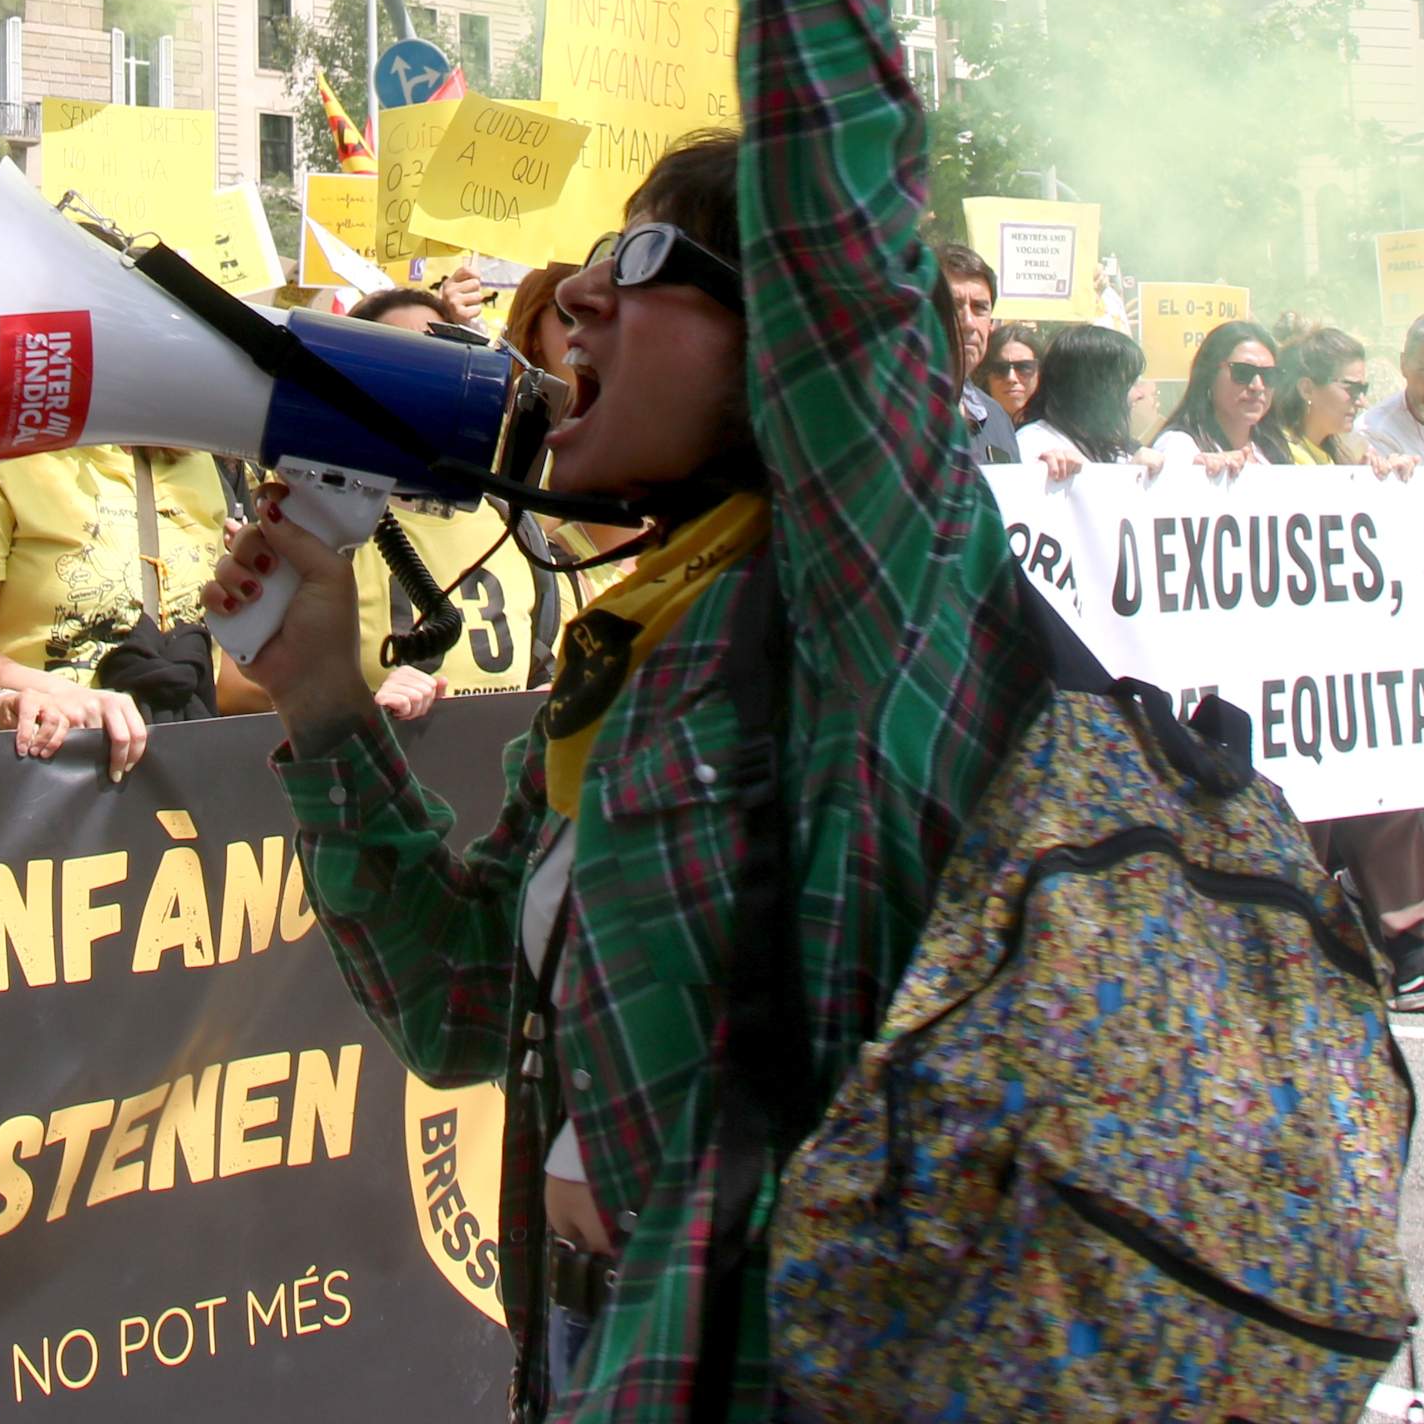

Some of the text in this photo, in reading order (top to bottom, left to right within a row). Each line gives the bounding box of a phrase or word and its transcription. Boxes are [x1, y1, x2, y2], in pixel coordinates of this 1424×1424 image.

[567, 44, 727, 116] VACANCES DE
[140, 115, 203, 146] DRETS
[474, 108, 550, 148] CUIDEU
[568, 118, 673, 176] ETMAN
[63, 147, 86, 171] NO
[140, 159, 169, 182] HA
[456, 141, 550, 190] A QUI
[385, 198, 417, 226] CO
[460, 181, 521, 228] CUIDA
[385, 230, 412, 260] EL
[1158, 299, 1179, 316] EL
[1186, 299, 1214, 317] 0-3
[12, 333, 48, 447] SINDICAL
[1112, 518, 1143, 617] 0
[1153, 512, 1402, 617] EXCUSES,
[420, 1107, 503, 1305] BRESS
[12, 1328, 98, 1403] NO
[120, 1295, 228, 1376] POT
[246, 1265, 353, 1347] MÉS
